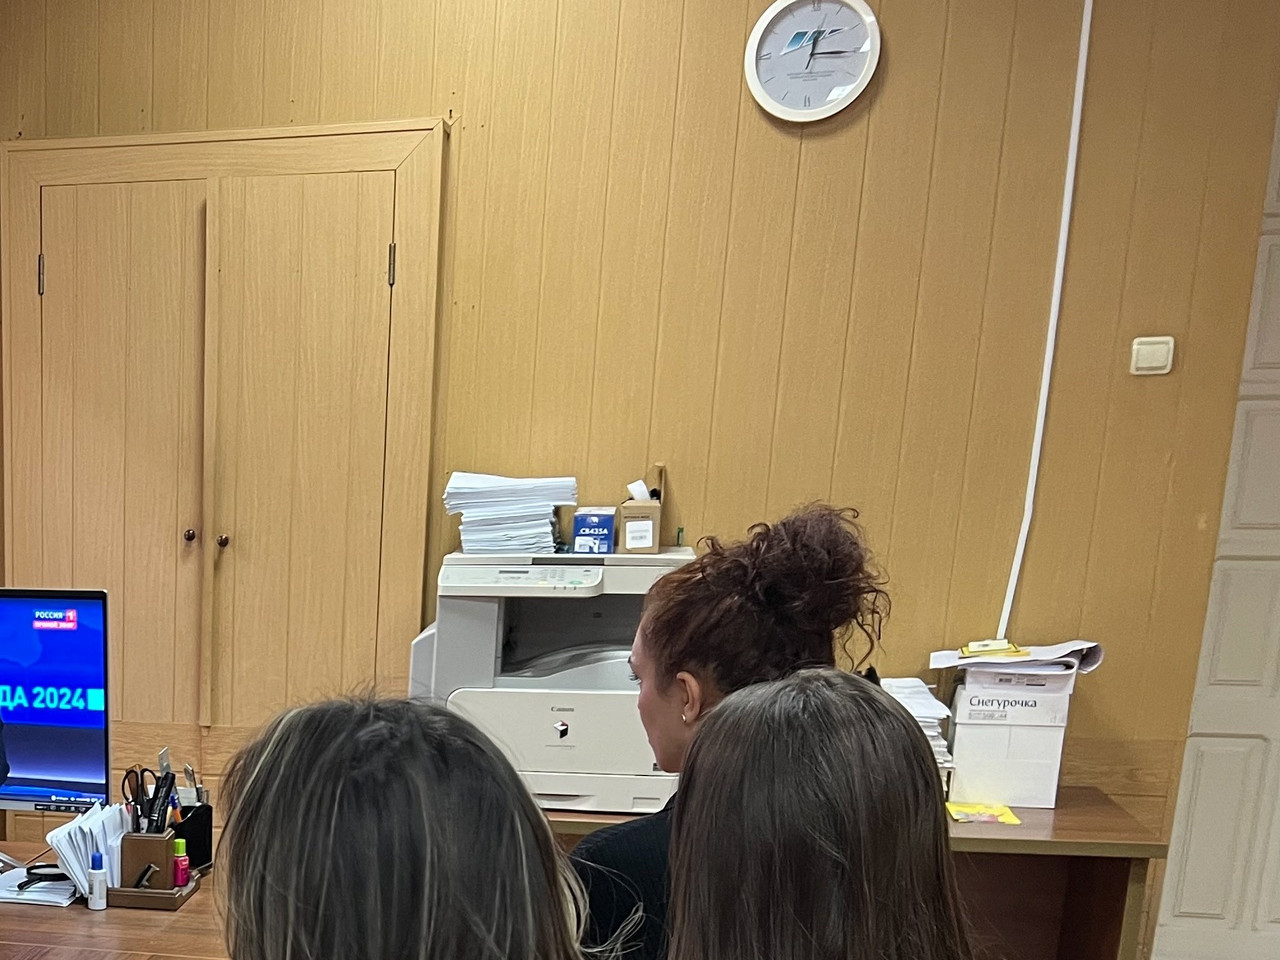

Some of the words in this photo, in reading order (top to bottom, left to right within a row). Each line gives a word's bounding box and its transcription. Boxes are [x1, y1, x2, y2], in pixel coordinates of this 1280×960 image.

[35, 611, 63, 619] РОССИЯ
[32, 687, 85, 710] 2024
[969, 695, 1037, 709] Снегурочка
